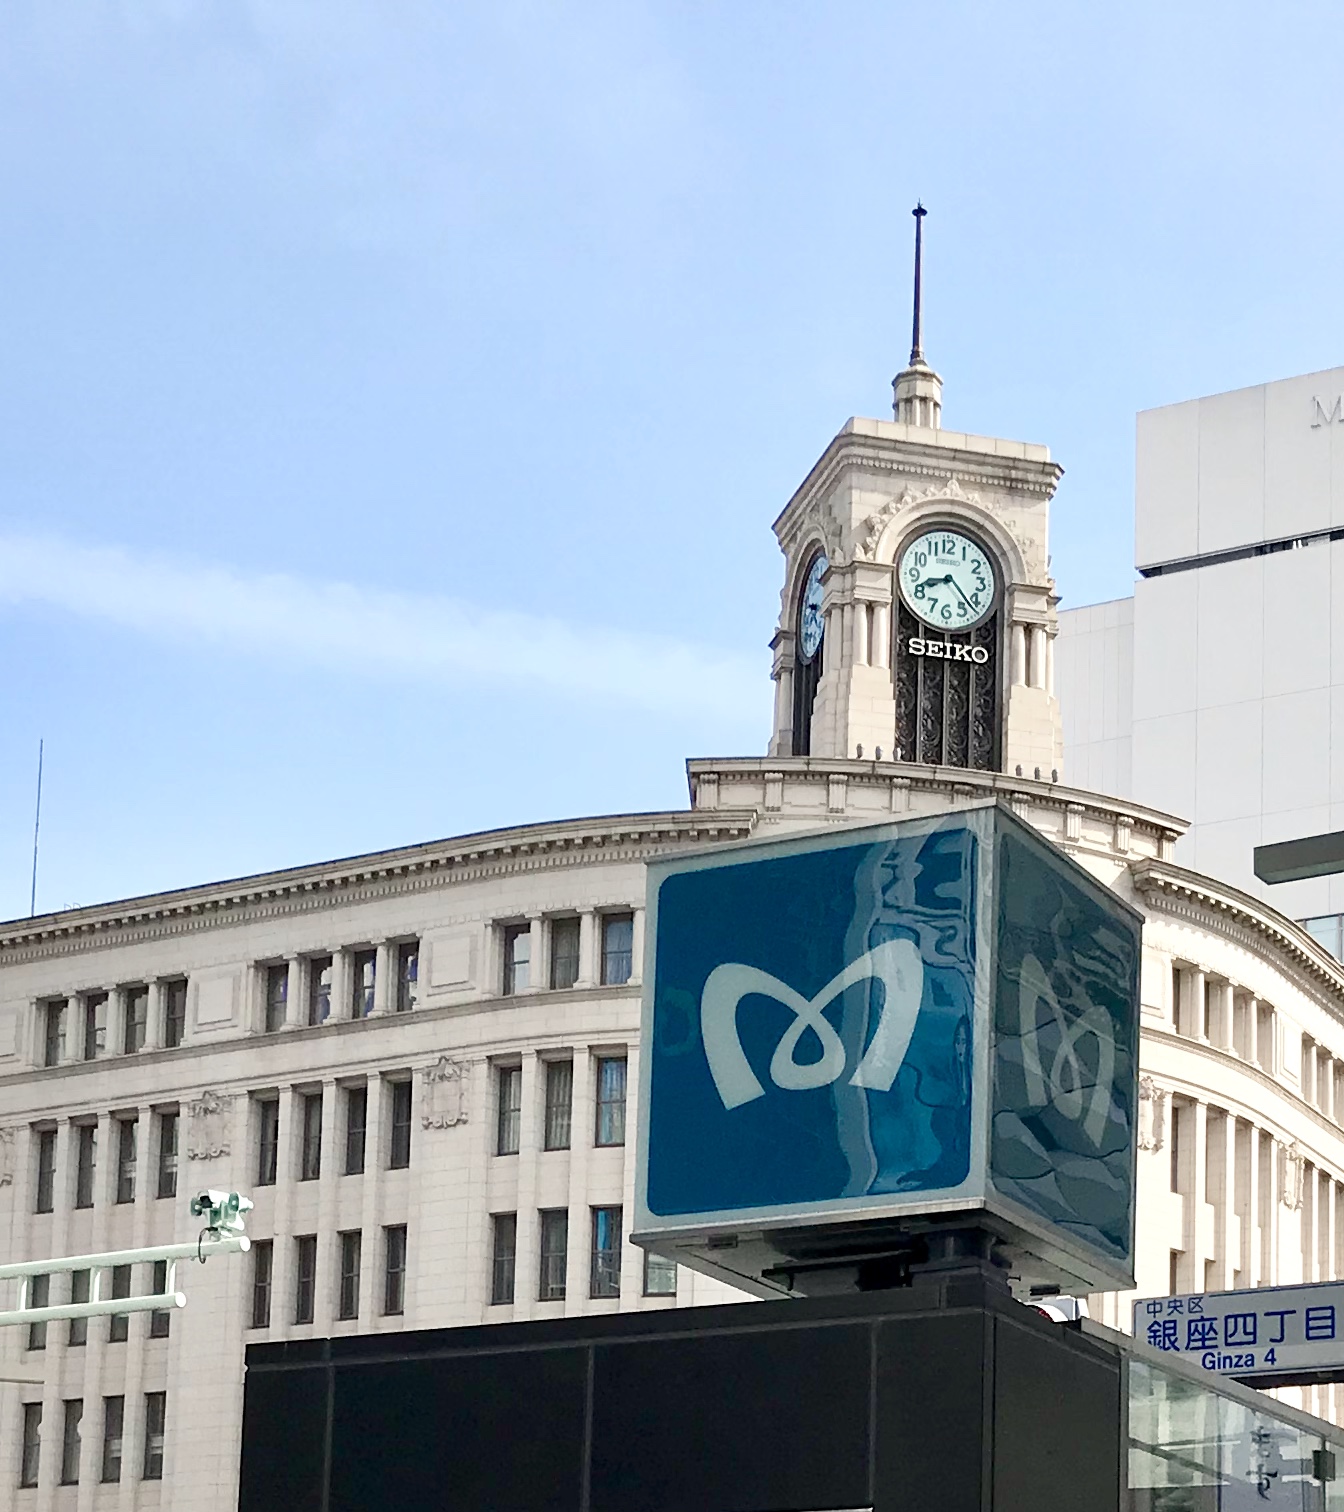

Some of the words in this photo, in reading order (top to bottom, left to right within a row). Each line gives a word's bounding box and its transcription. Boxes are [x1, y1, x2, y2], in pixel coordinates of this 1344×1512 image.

[928, 541, 938, 556] 11
[942, 539, 956, 555] 12
[962, 546, 966, 561] 1
[915, 552, 927, 568] 10
[971, 559, 982, 575] 2
[909, 567, 920, 583] 9
[914, 584, 925, 600] 8
[976, 577, 986, 592] 3
[927, 598, 938, 613] 7
[970, 593, 981, 607] 4
[941, 604, 952, 620] 6
[957, 602, 967, 617] 5
[908, 637, 989, 664] SEIKO
[1144, 1297, 1205, 1317] 中央区
[1145, 1304, 1337, 1354] 銀座四丁目
[1201, 1353, 1255, 1371] Ginza
[1263, 1350, 1277, 1367] 4
